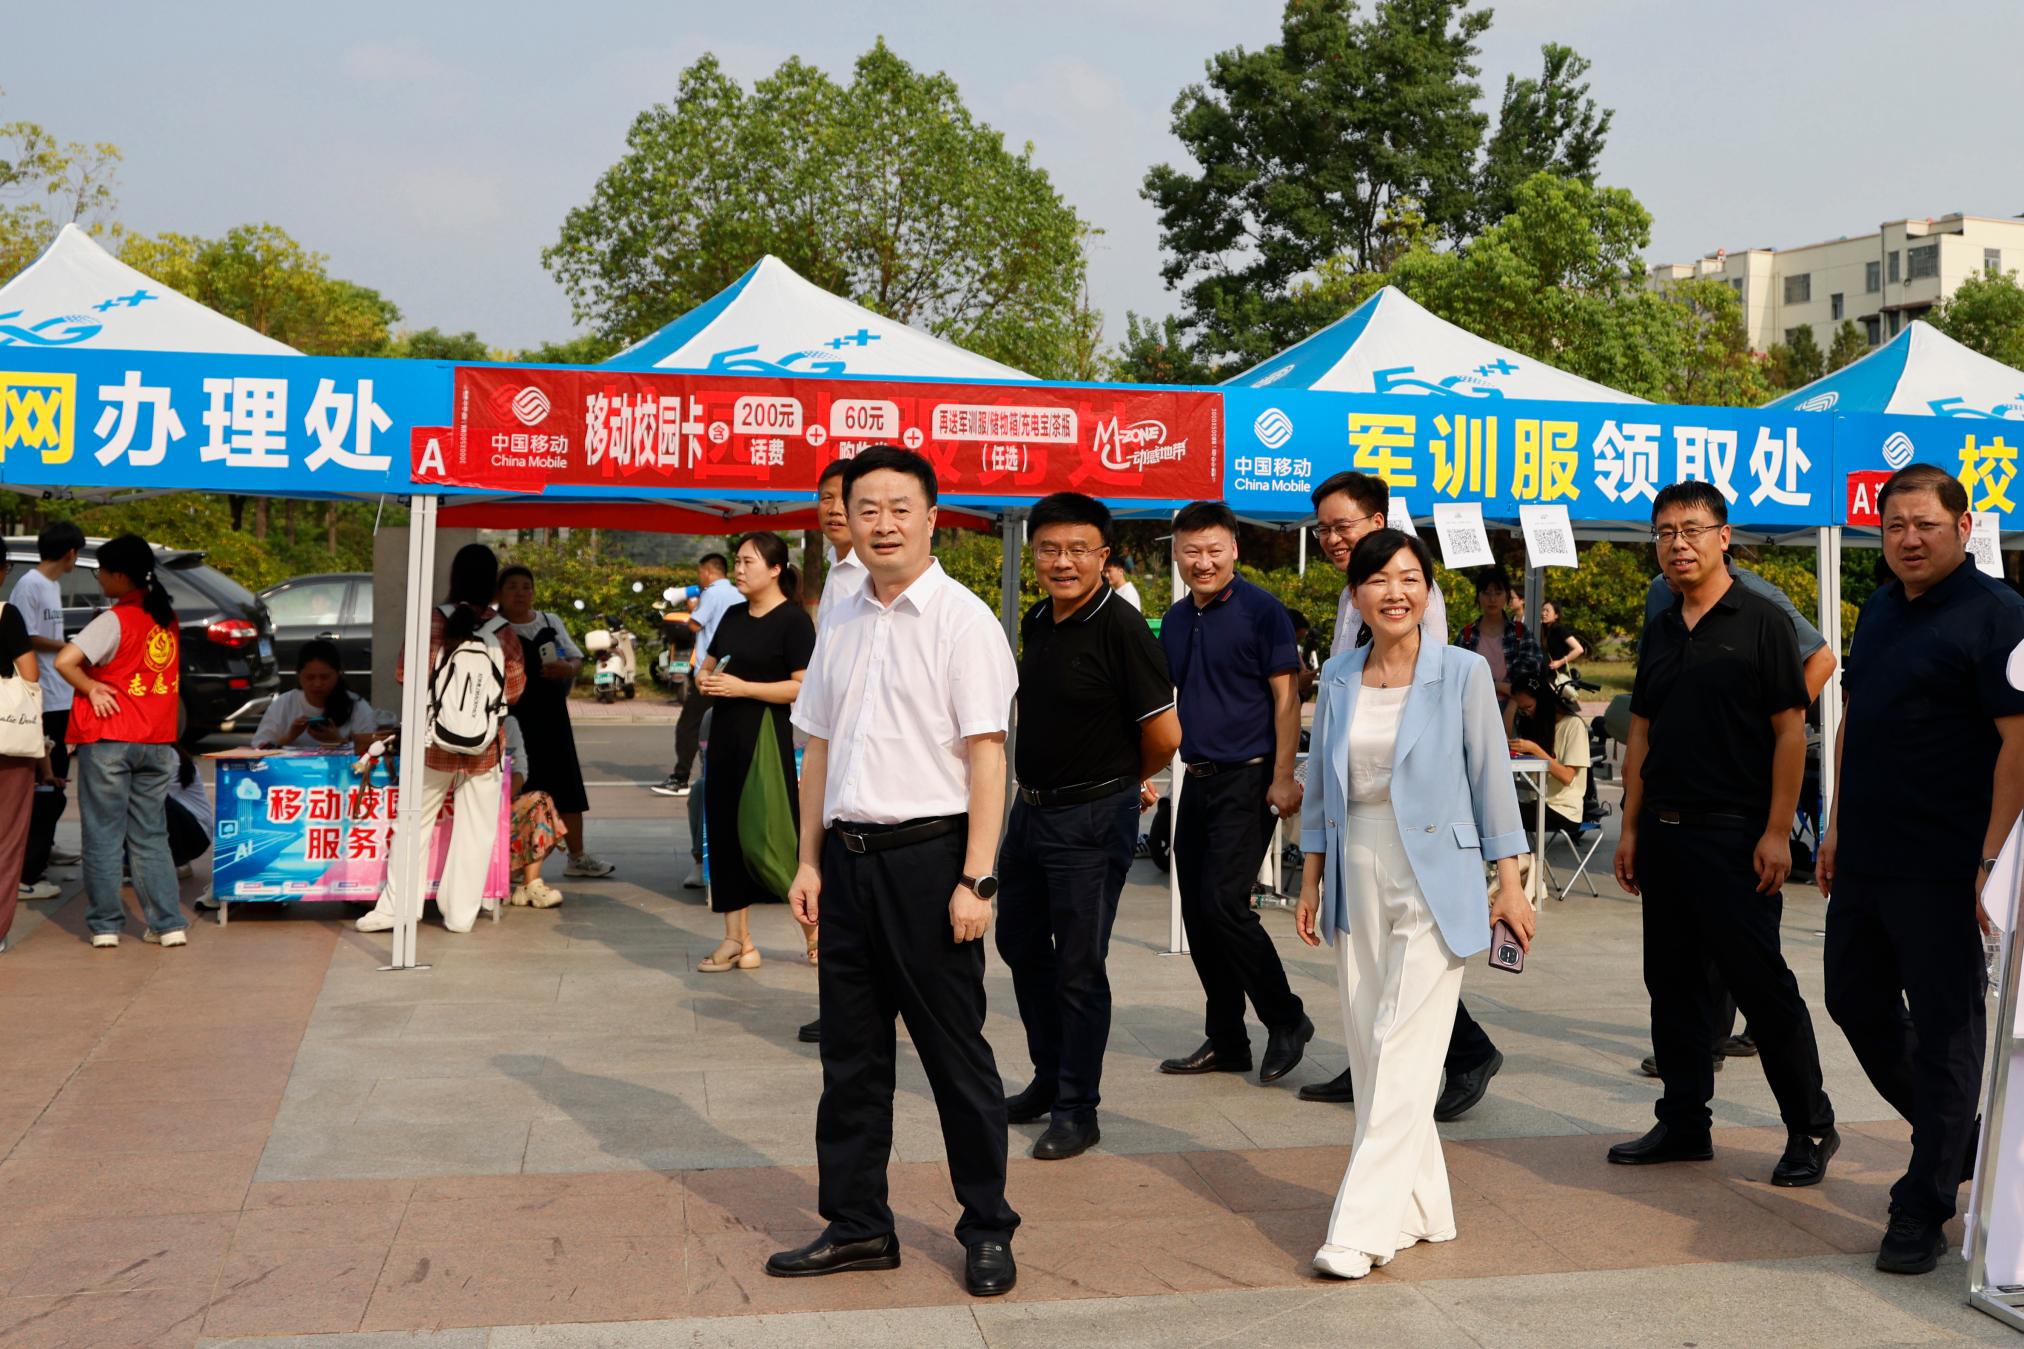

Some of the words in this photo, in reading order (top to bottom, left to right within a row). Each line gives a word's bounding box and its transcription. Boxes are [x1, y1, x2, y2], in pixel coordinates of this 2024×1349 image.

[0, 370, 393, 472] 网办理处
[741, 403, 794, 428] 200元
[845, 406, 884, 431] 60元
[491, 433, 568, 454] 中国移动
[584, 392, 704, 469] 移动校园卡
[418, 438, 446, 476] A
[491, 454, 526, 468] China
[528, 455, 568, 469] Mobile
[750, 438, 785, 466] 话费
[982, 443, 1028, 473] (任选)
[1126, 438, 1188, 472] 动感地带
[1234, 456, 1312, 477] 中国移动
[1348, 412, 1812, 508] 军训服领取处
[1234, 478, 1270, 491] China
[1272, 479, 1311, 493] Mobile
[1957, 434, 2018, 514] 校
